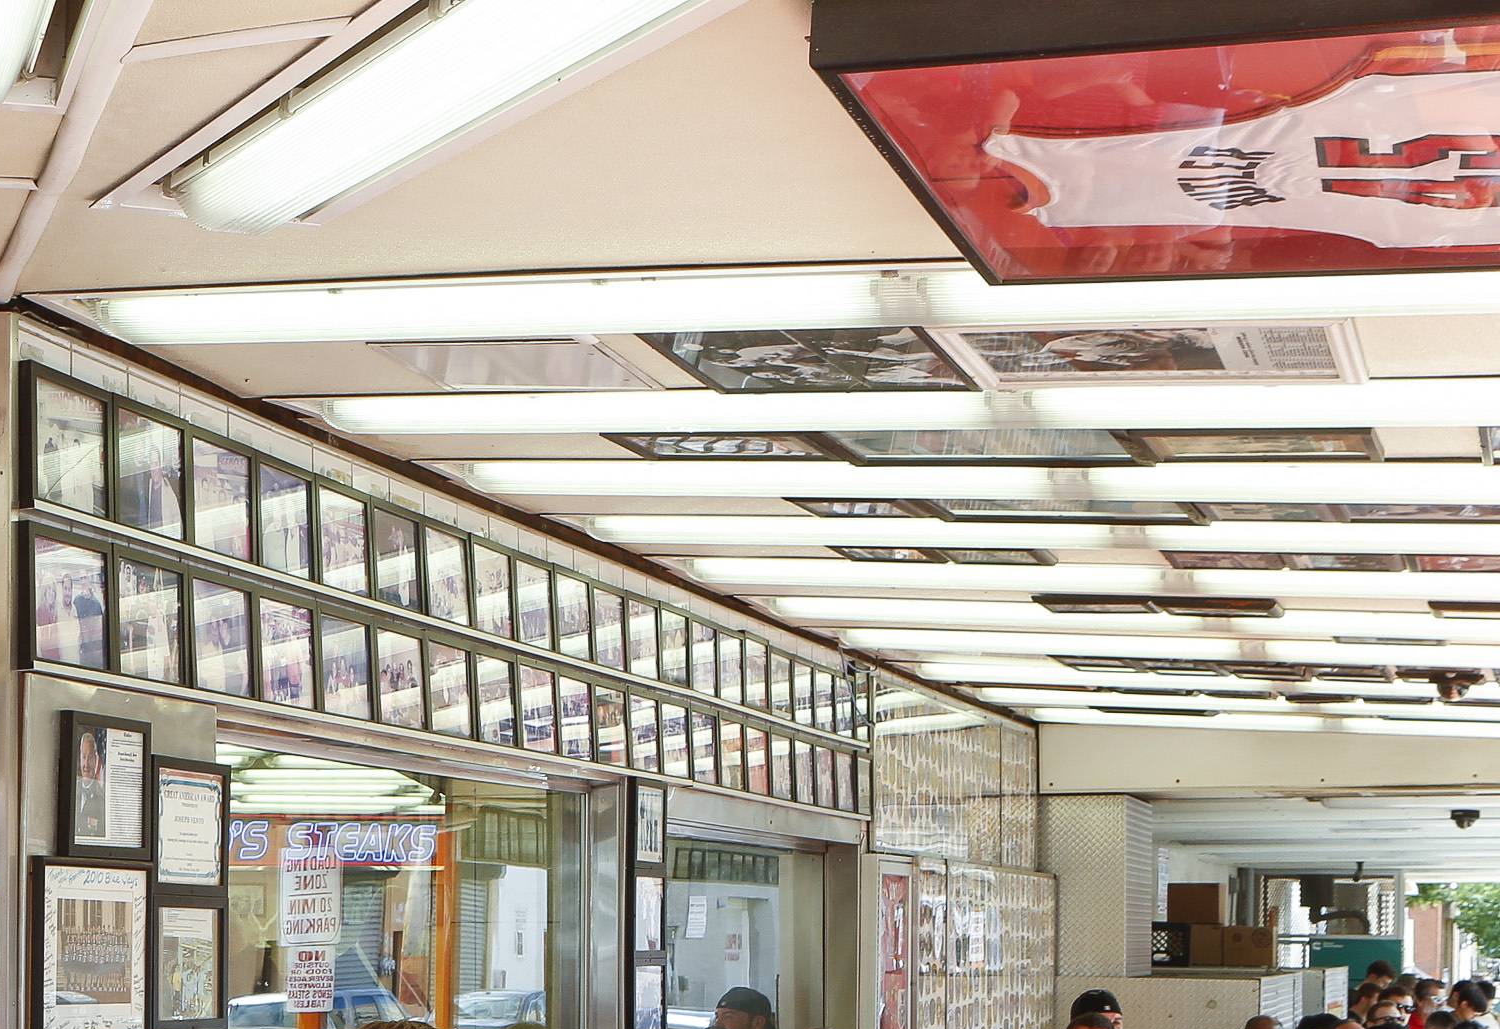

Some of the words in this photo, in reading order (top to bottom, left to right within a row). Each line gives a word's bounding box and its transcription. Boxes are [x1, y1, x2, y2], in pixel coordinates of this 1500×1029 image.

[1177, 145, 1287, 210] BUTLER
[1315, 133, 1500, 210] 45
[285, 822, 438, 862] STEAKS
